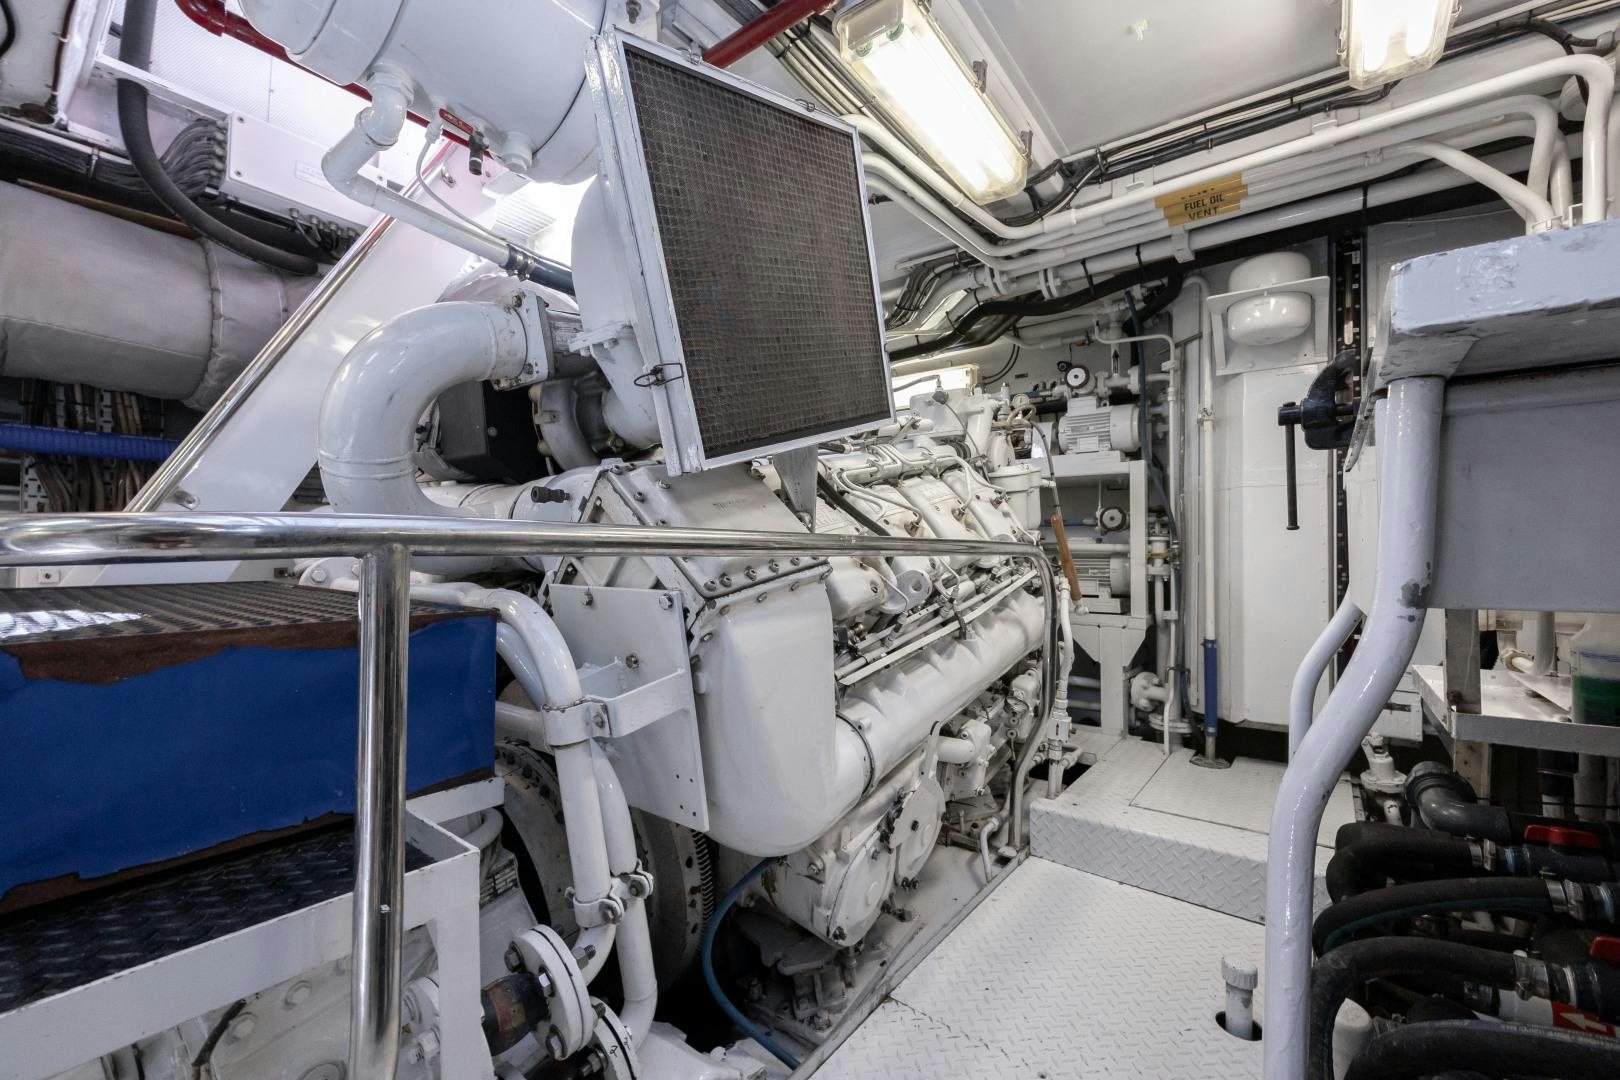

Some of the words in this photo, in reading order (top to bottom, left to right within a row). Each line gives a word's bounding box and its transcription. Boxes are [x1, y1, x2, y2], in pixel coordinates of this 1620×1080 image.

[1184, 199, 1207, 211] FUEL
[1209, 193, 1223, 205] OIL
[1189, 206, 1219, 221] VENT
